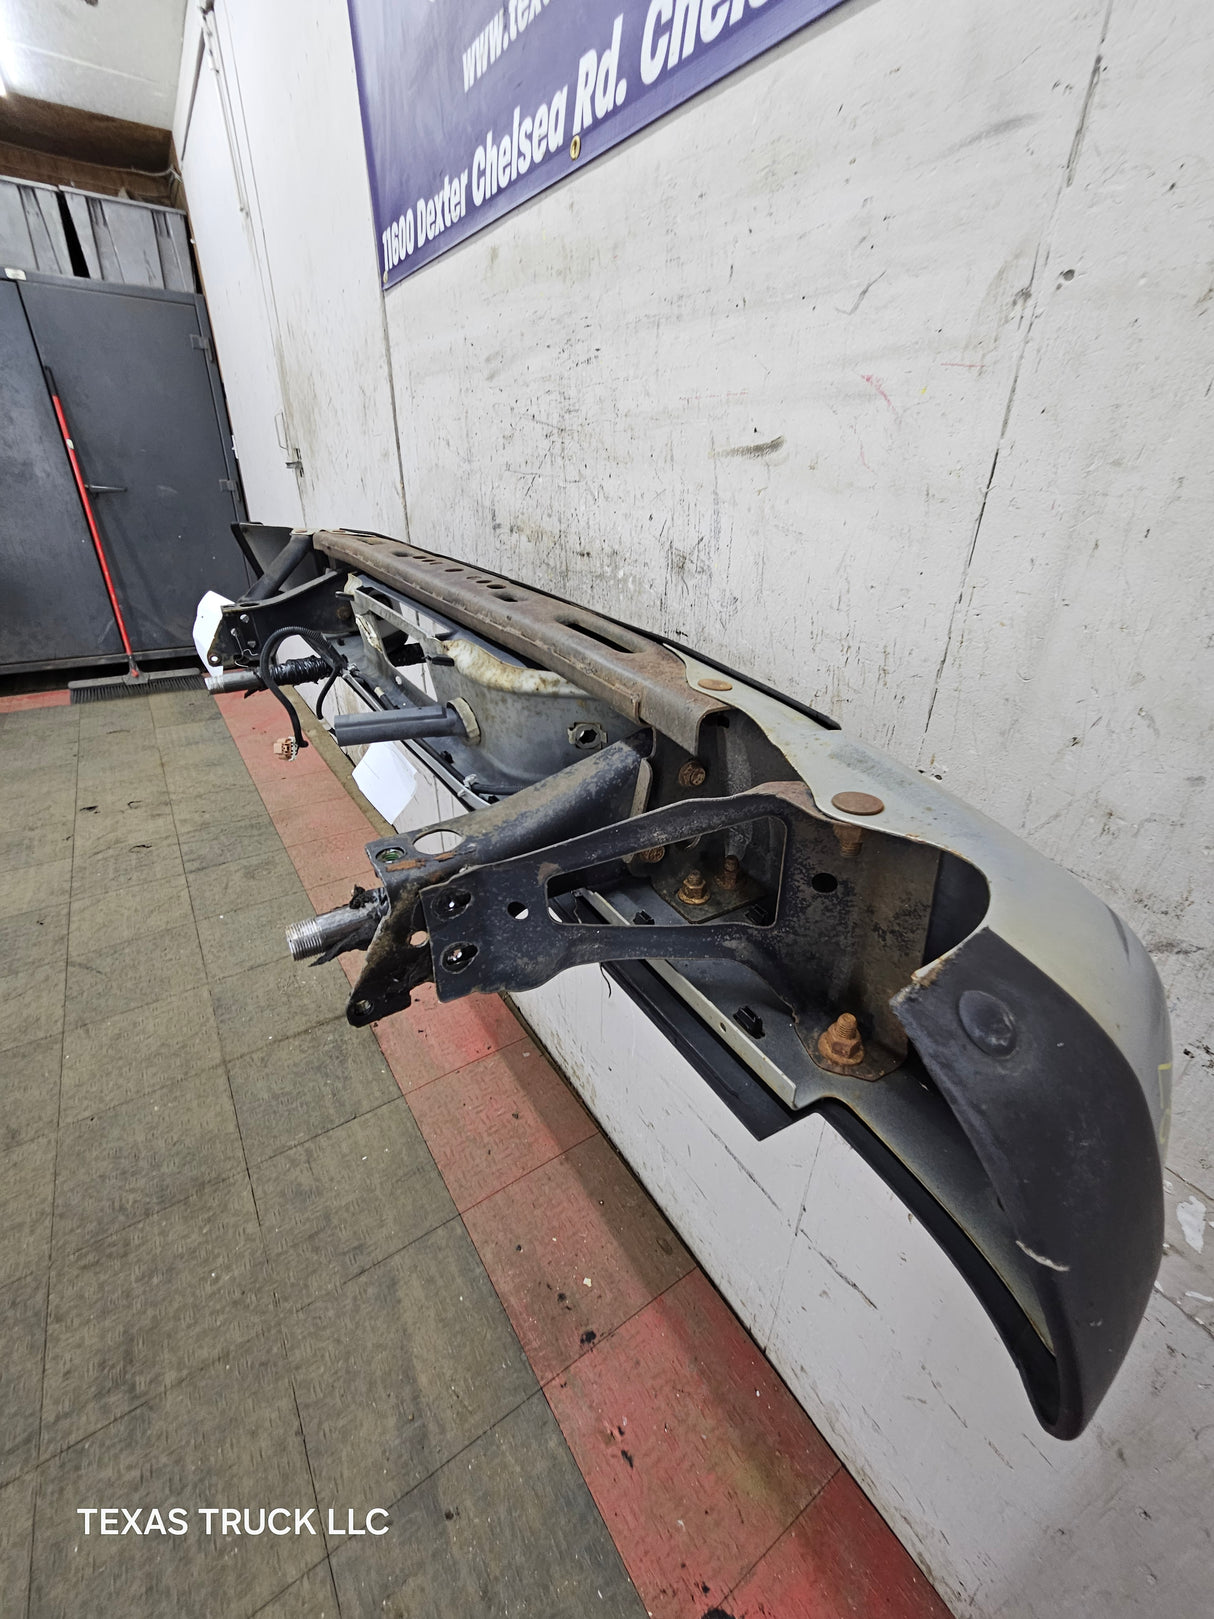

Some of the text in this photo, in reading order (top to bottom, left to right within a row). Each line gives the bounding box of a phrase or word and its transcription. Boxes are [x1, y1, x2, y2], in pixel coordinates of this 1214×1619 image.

[382, 207, 414, 273] 11600
[417, 167, 468, 248] Dexter
[472, 84, 568, 207] Chelsea
[573, 12, 627, 136] Rd.
